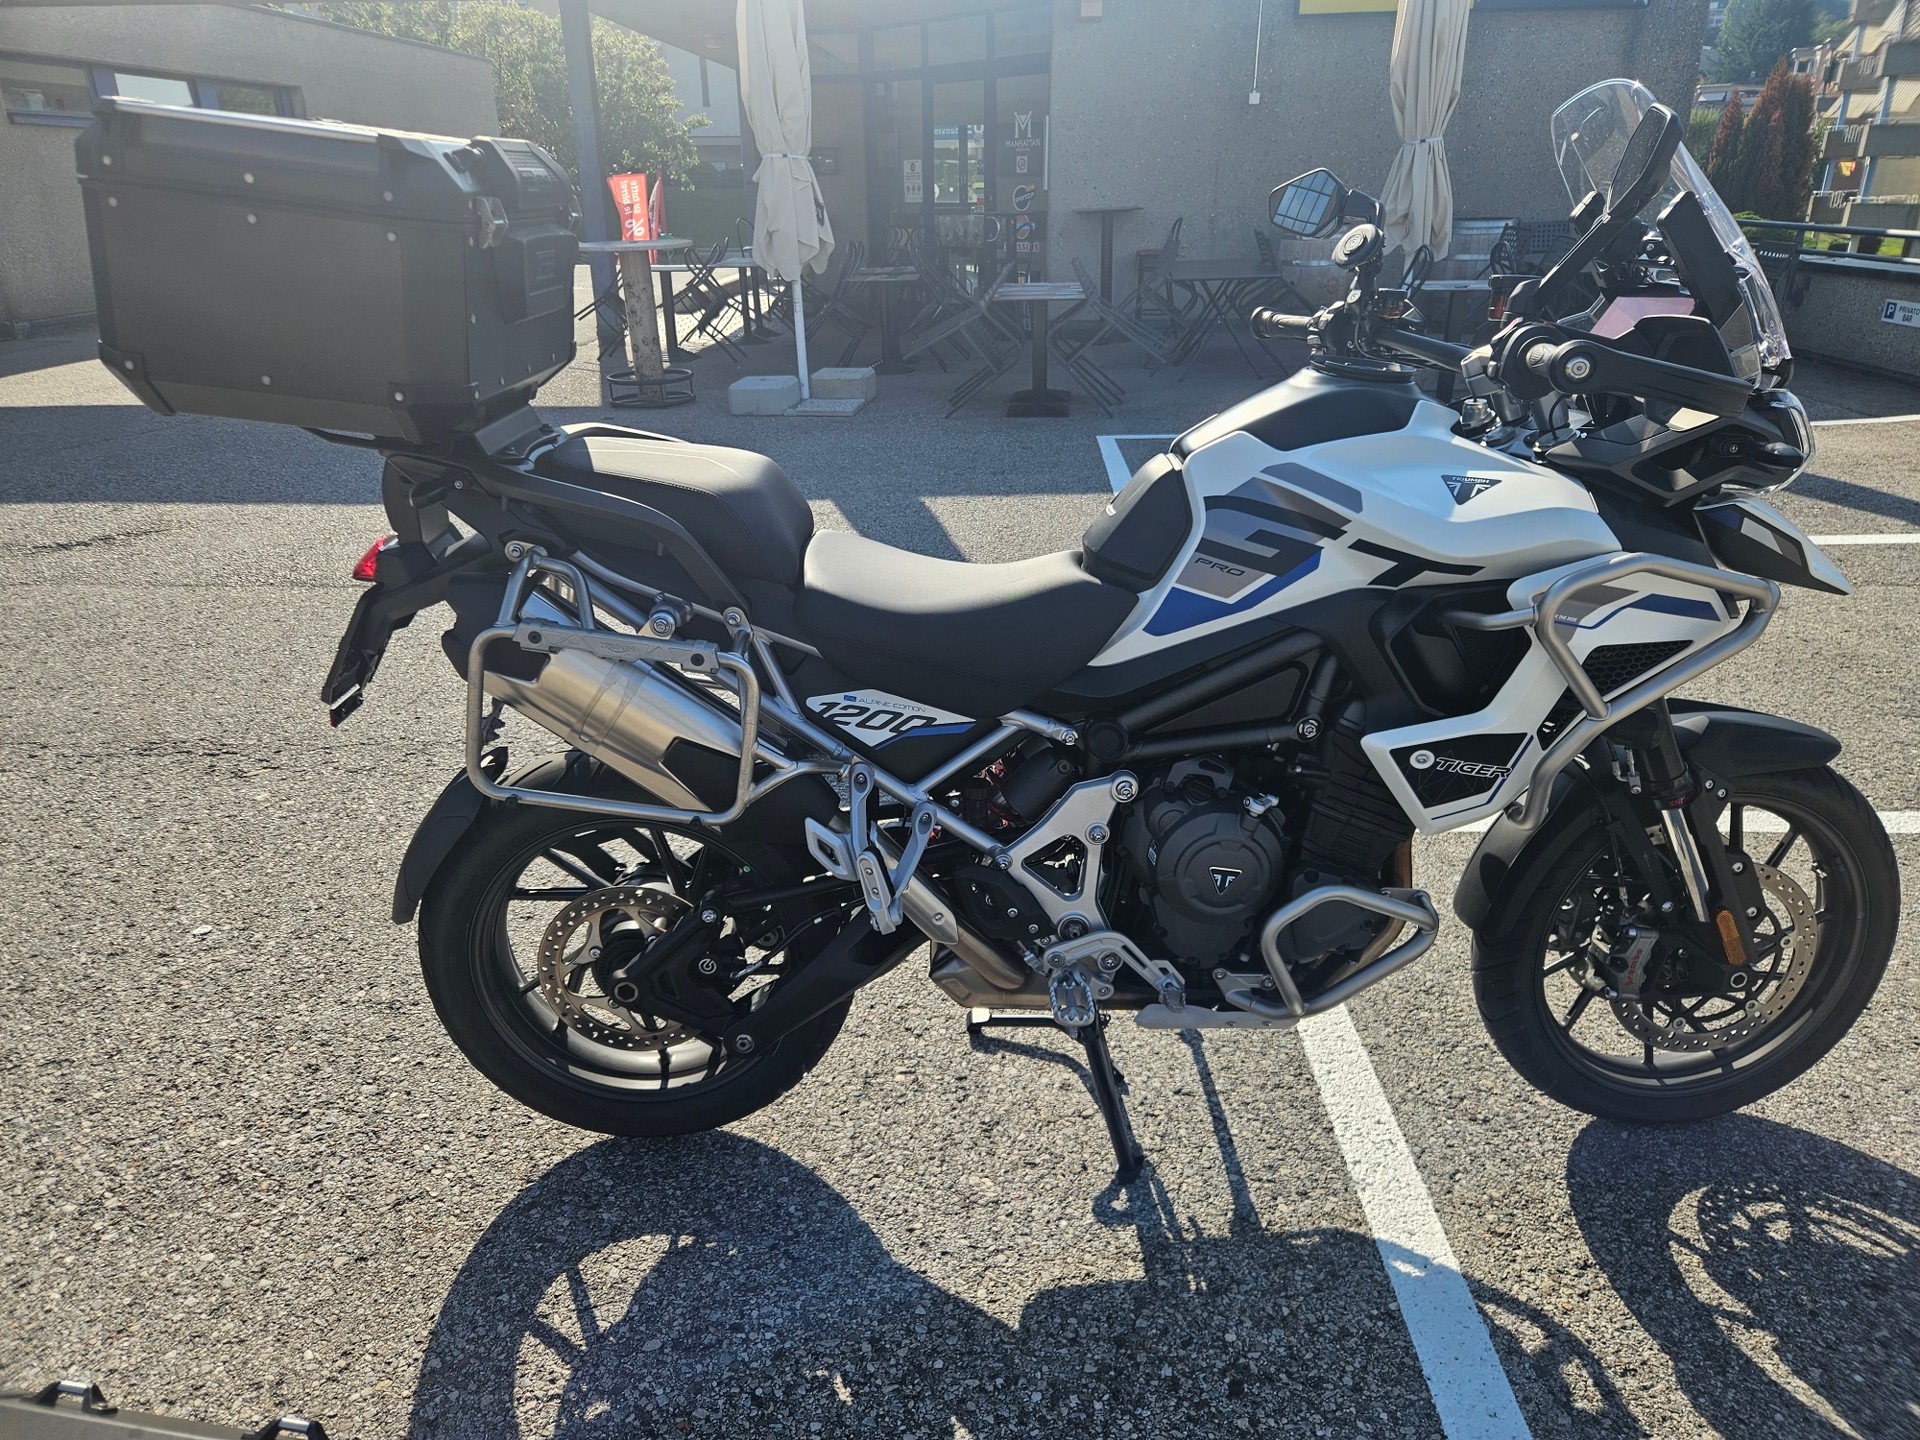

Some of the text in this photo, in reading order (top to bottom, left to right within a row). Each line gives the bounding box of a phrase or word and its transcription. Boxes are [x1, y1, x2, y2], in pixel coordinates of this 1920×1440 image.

[1005, 138, 1040, 149] MANHATTAN
[1902, 314, 1912, 322] BAR
[1452, 476, 1490, 484] TRIUMPH
[1194, 557, 1246, 577] PRO
[858, 697, 927, 713] ALPINE EDITION
[818, 702, 937, 734] 1200
[1436, 757, 1512, 780] TIGER
[1625, 949, 1643, 986] brembo
